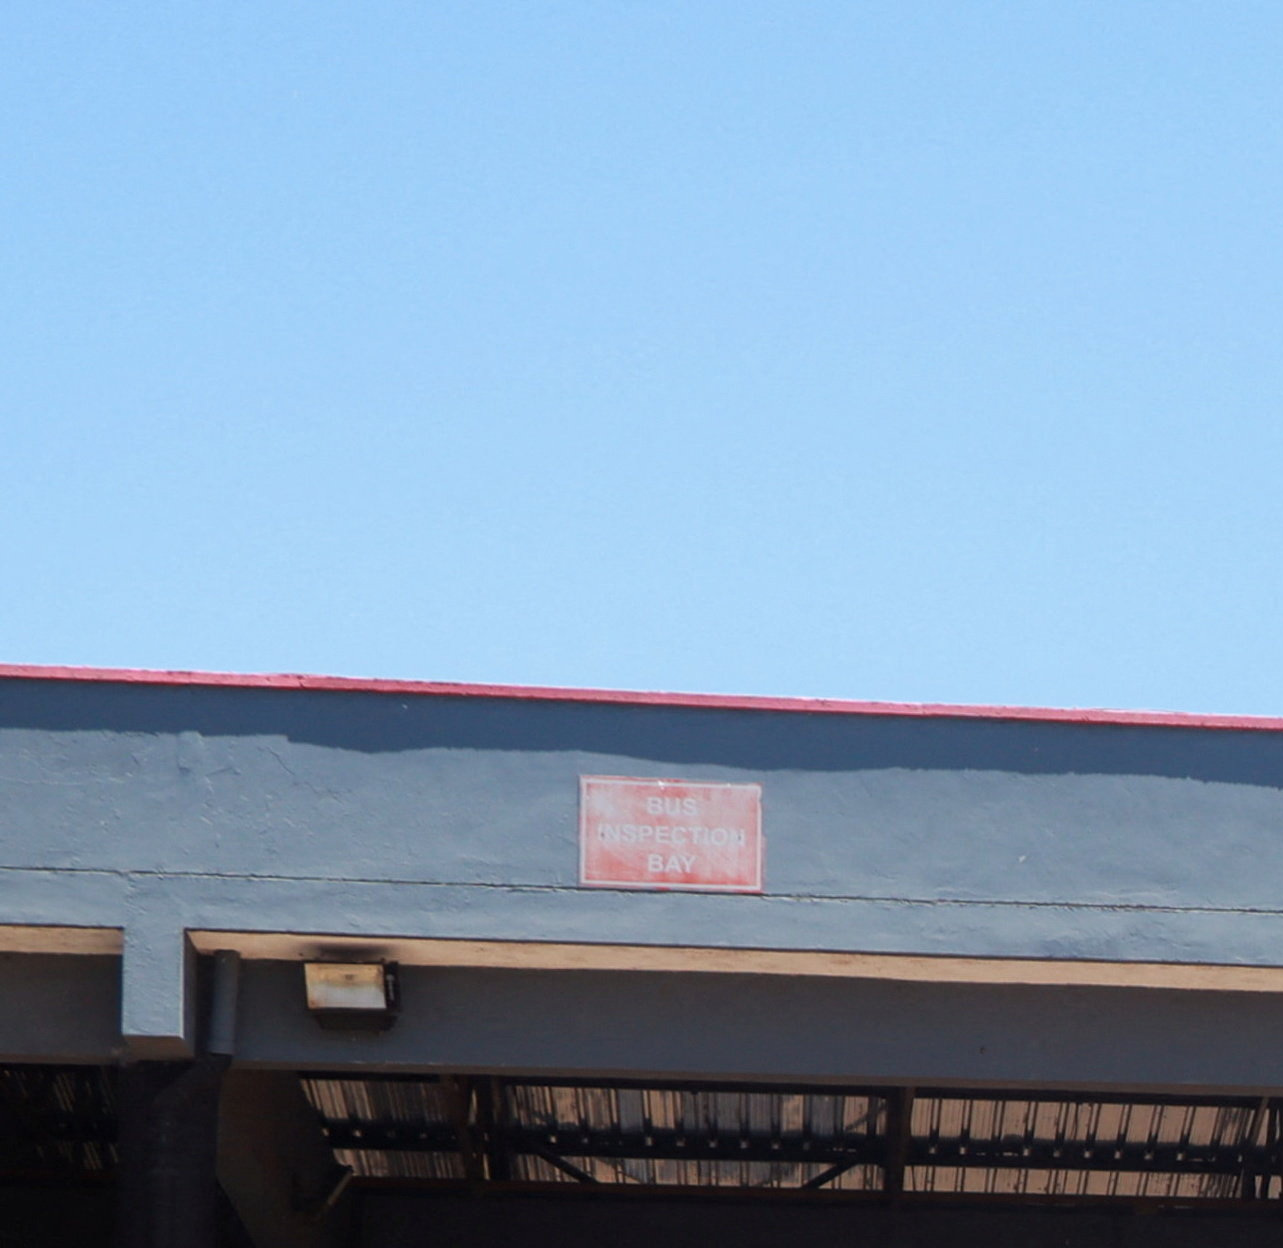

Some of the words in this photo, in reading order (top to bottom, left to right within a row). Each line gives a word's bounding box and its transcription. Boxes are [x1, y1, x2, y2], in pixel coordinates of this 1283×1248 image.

[646, 796, 700, 816] BUS
[598, 823, 746, 847] INSPECTION
[648, 854, 698, 874] BAY
